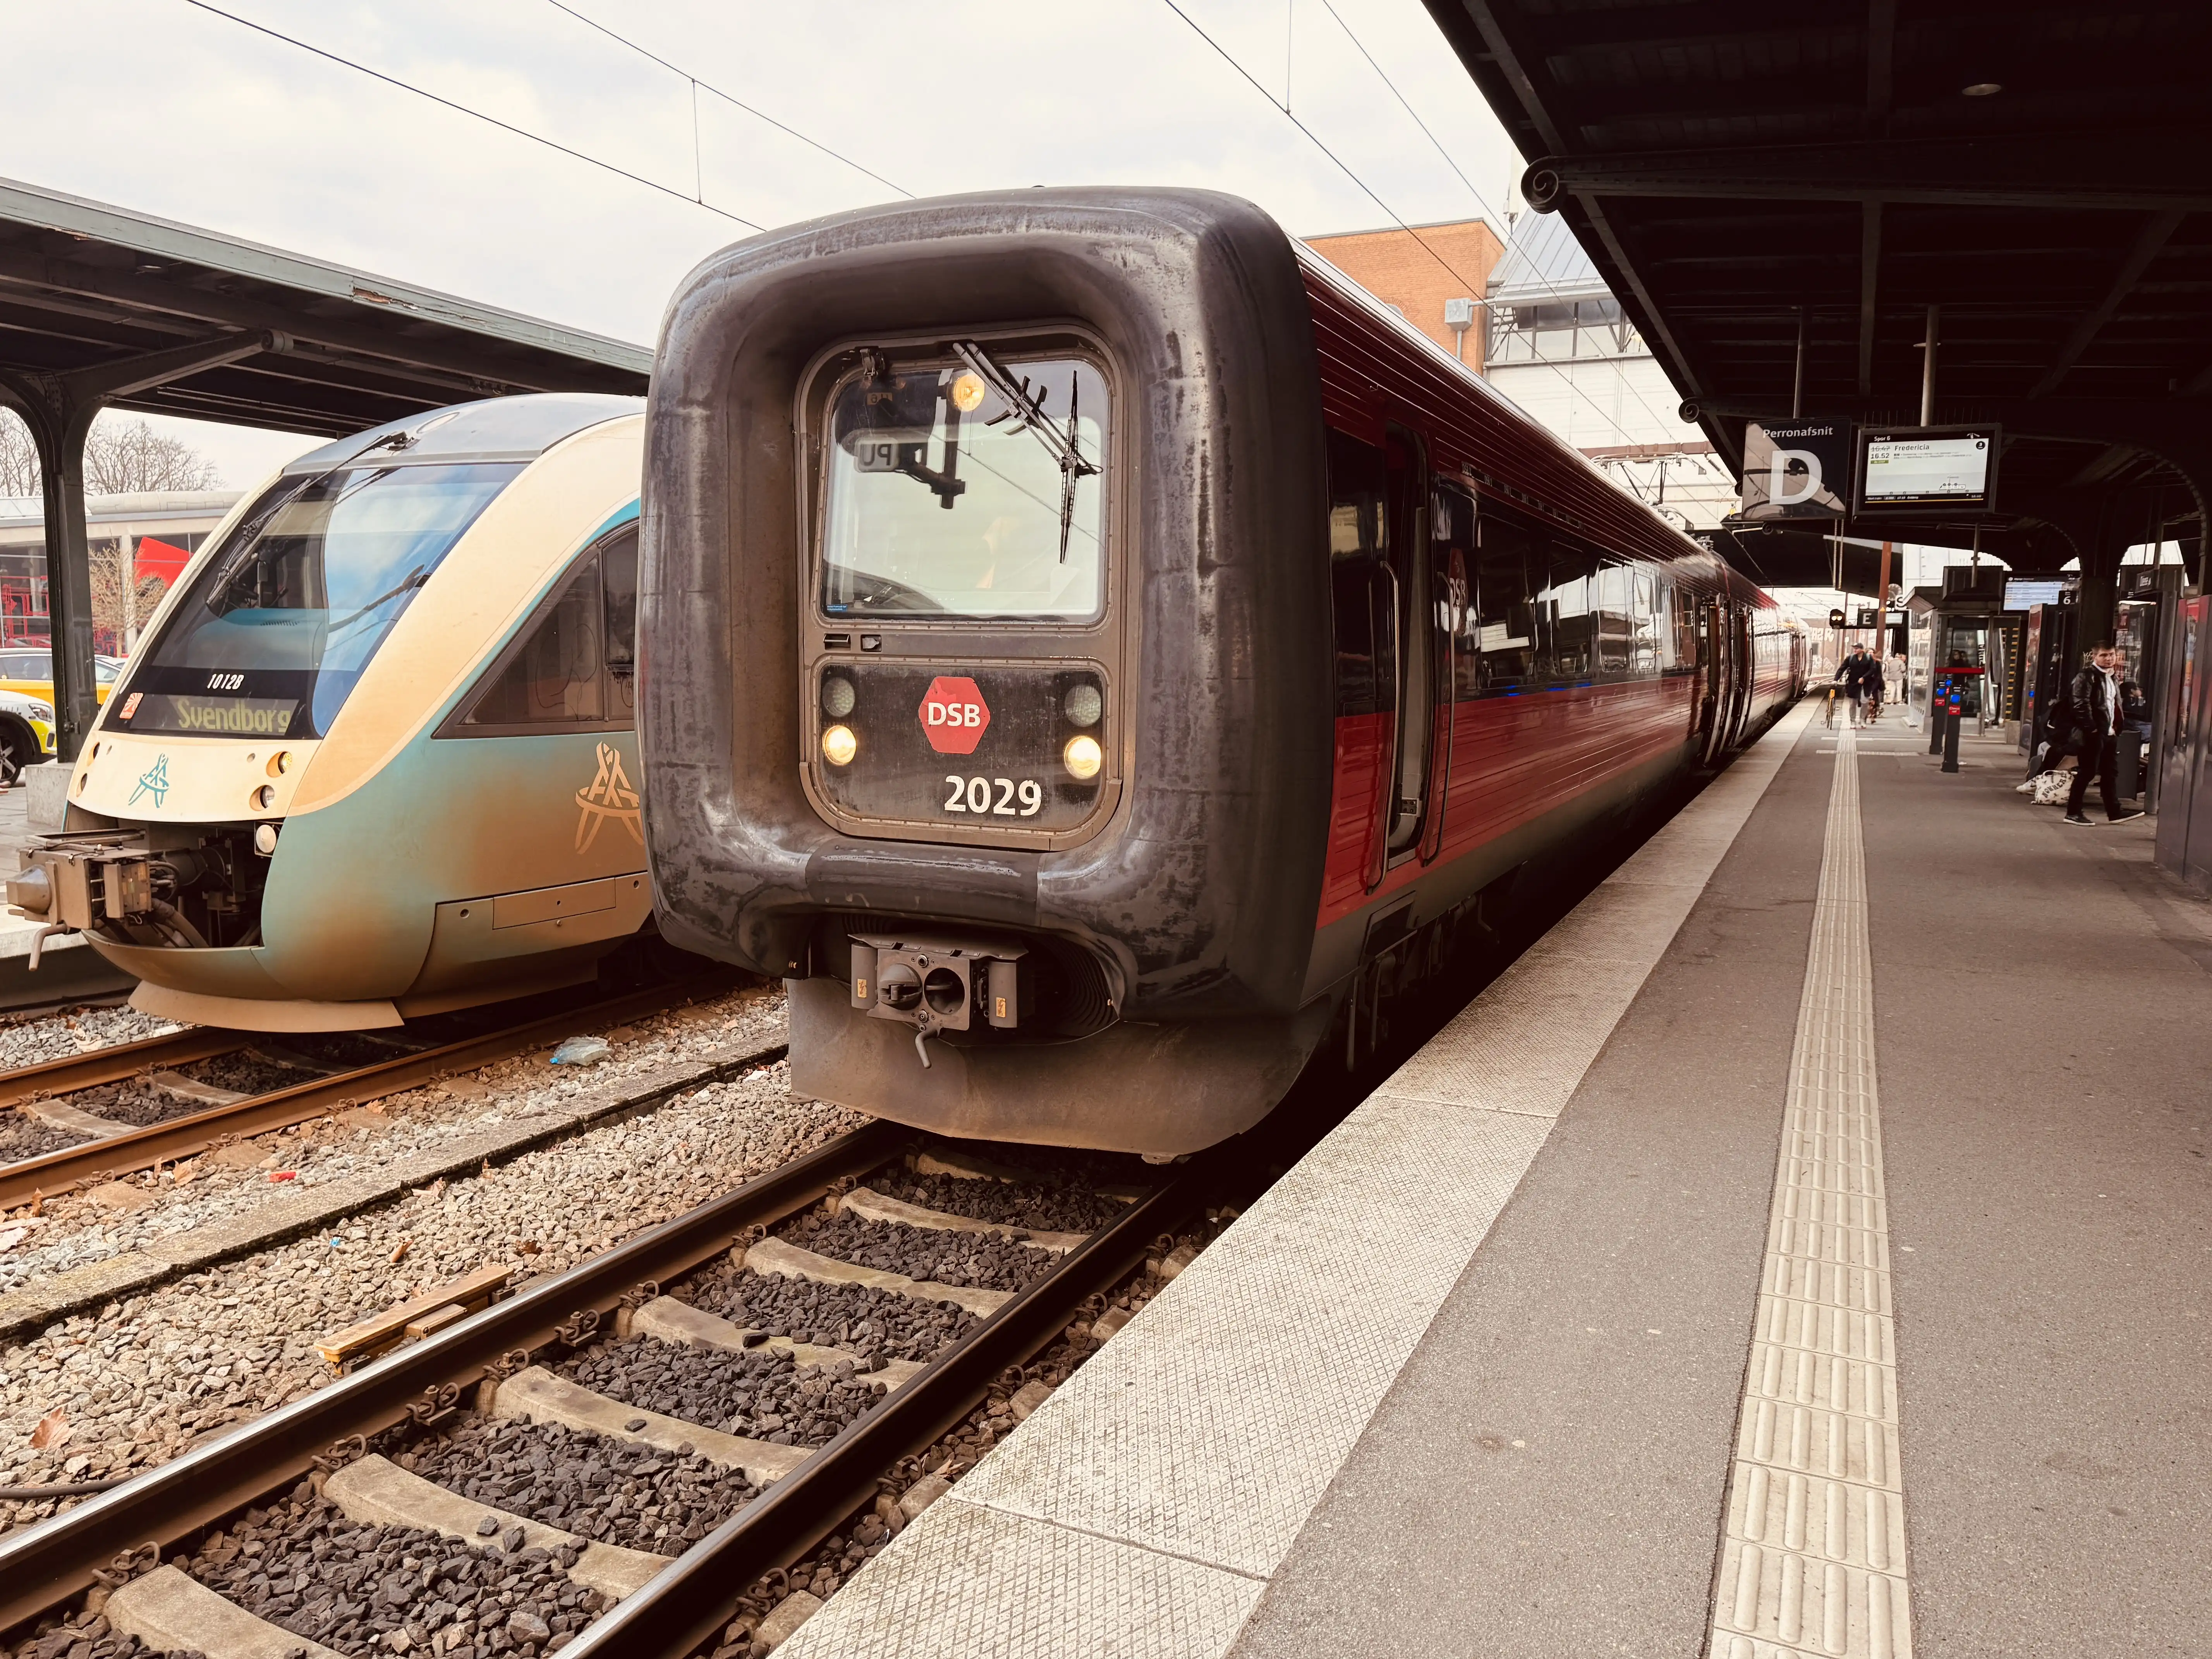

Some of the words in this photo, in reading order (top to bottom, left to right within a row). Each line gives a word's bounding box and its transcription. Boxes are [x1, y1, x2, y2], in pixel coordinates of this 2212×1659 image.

[1763, 426, 1833, 438] Perronafsnit
[1769, 450, 1822, 505] D
[2063, 596, 2071, 605] 6
[1862, 613, 1872, 624] E
[207, 673, 244, 690] 1012B
[177, 697, 291, 733] Svendborg
[927, 702, 981, 727] DSB
[944, 775, 1042, 816] 2029
